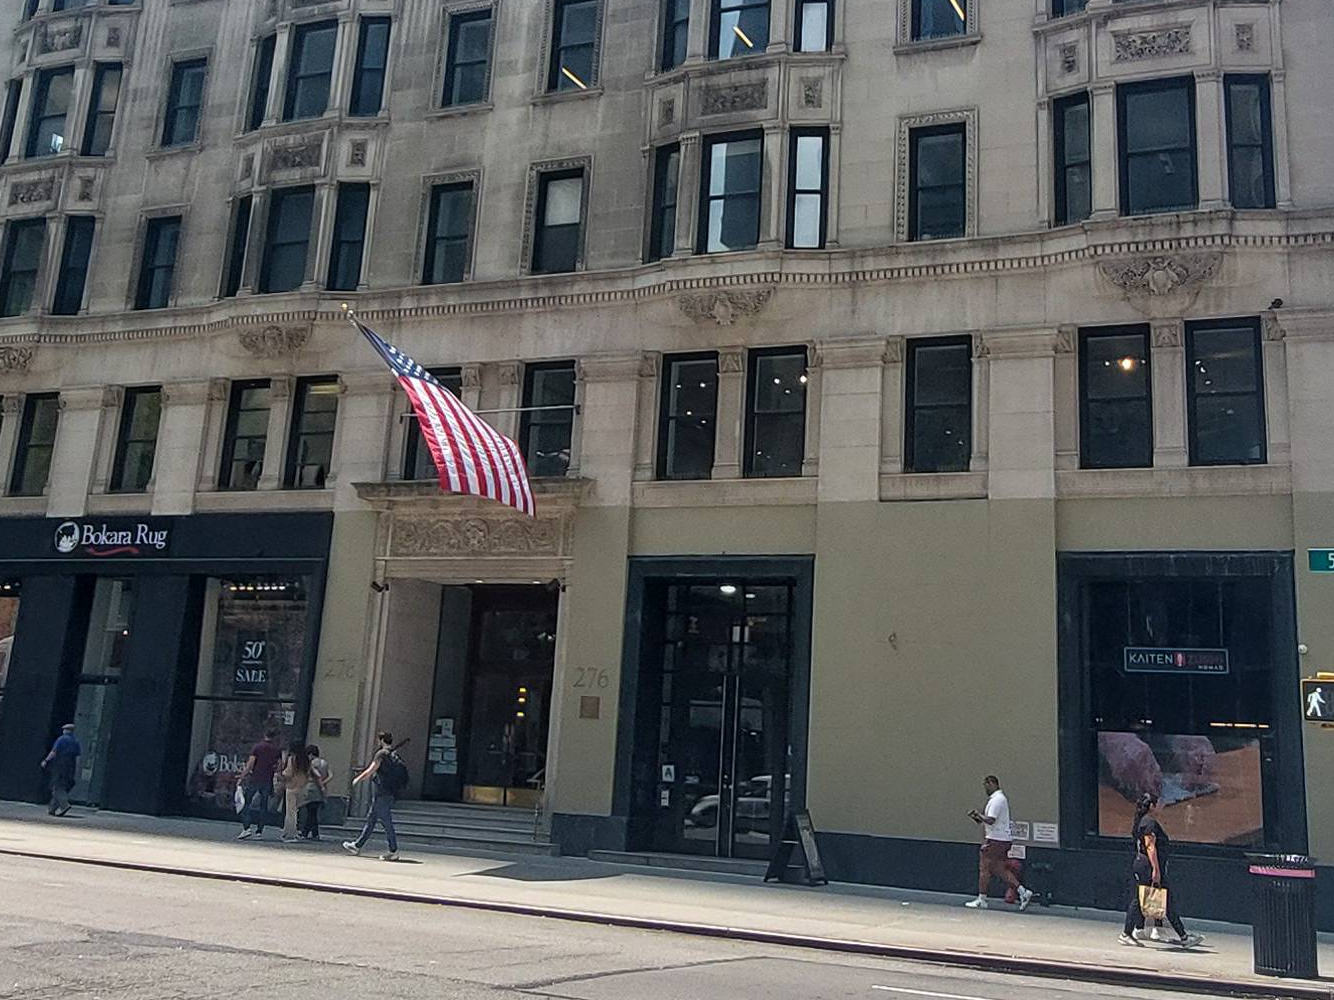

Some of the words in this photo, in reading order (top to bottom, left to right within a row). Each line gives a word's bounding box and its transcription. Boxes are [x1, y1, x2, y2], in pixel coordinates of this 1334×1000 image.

[81, 524, 131, 545] Bokara
[135, 524, 168, 550] Rug
[1129, 654, 1173, 664] KAITEN
[236, 669, 267, 682] SALE
[572, 666, 609, 688] 276
[219, 754, 246, 772] Boka
